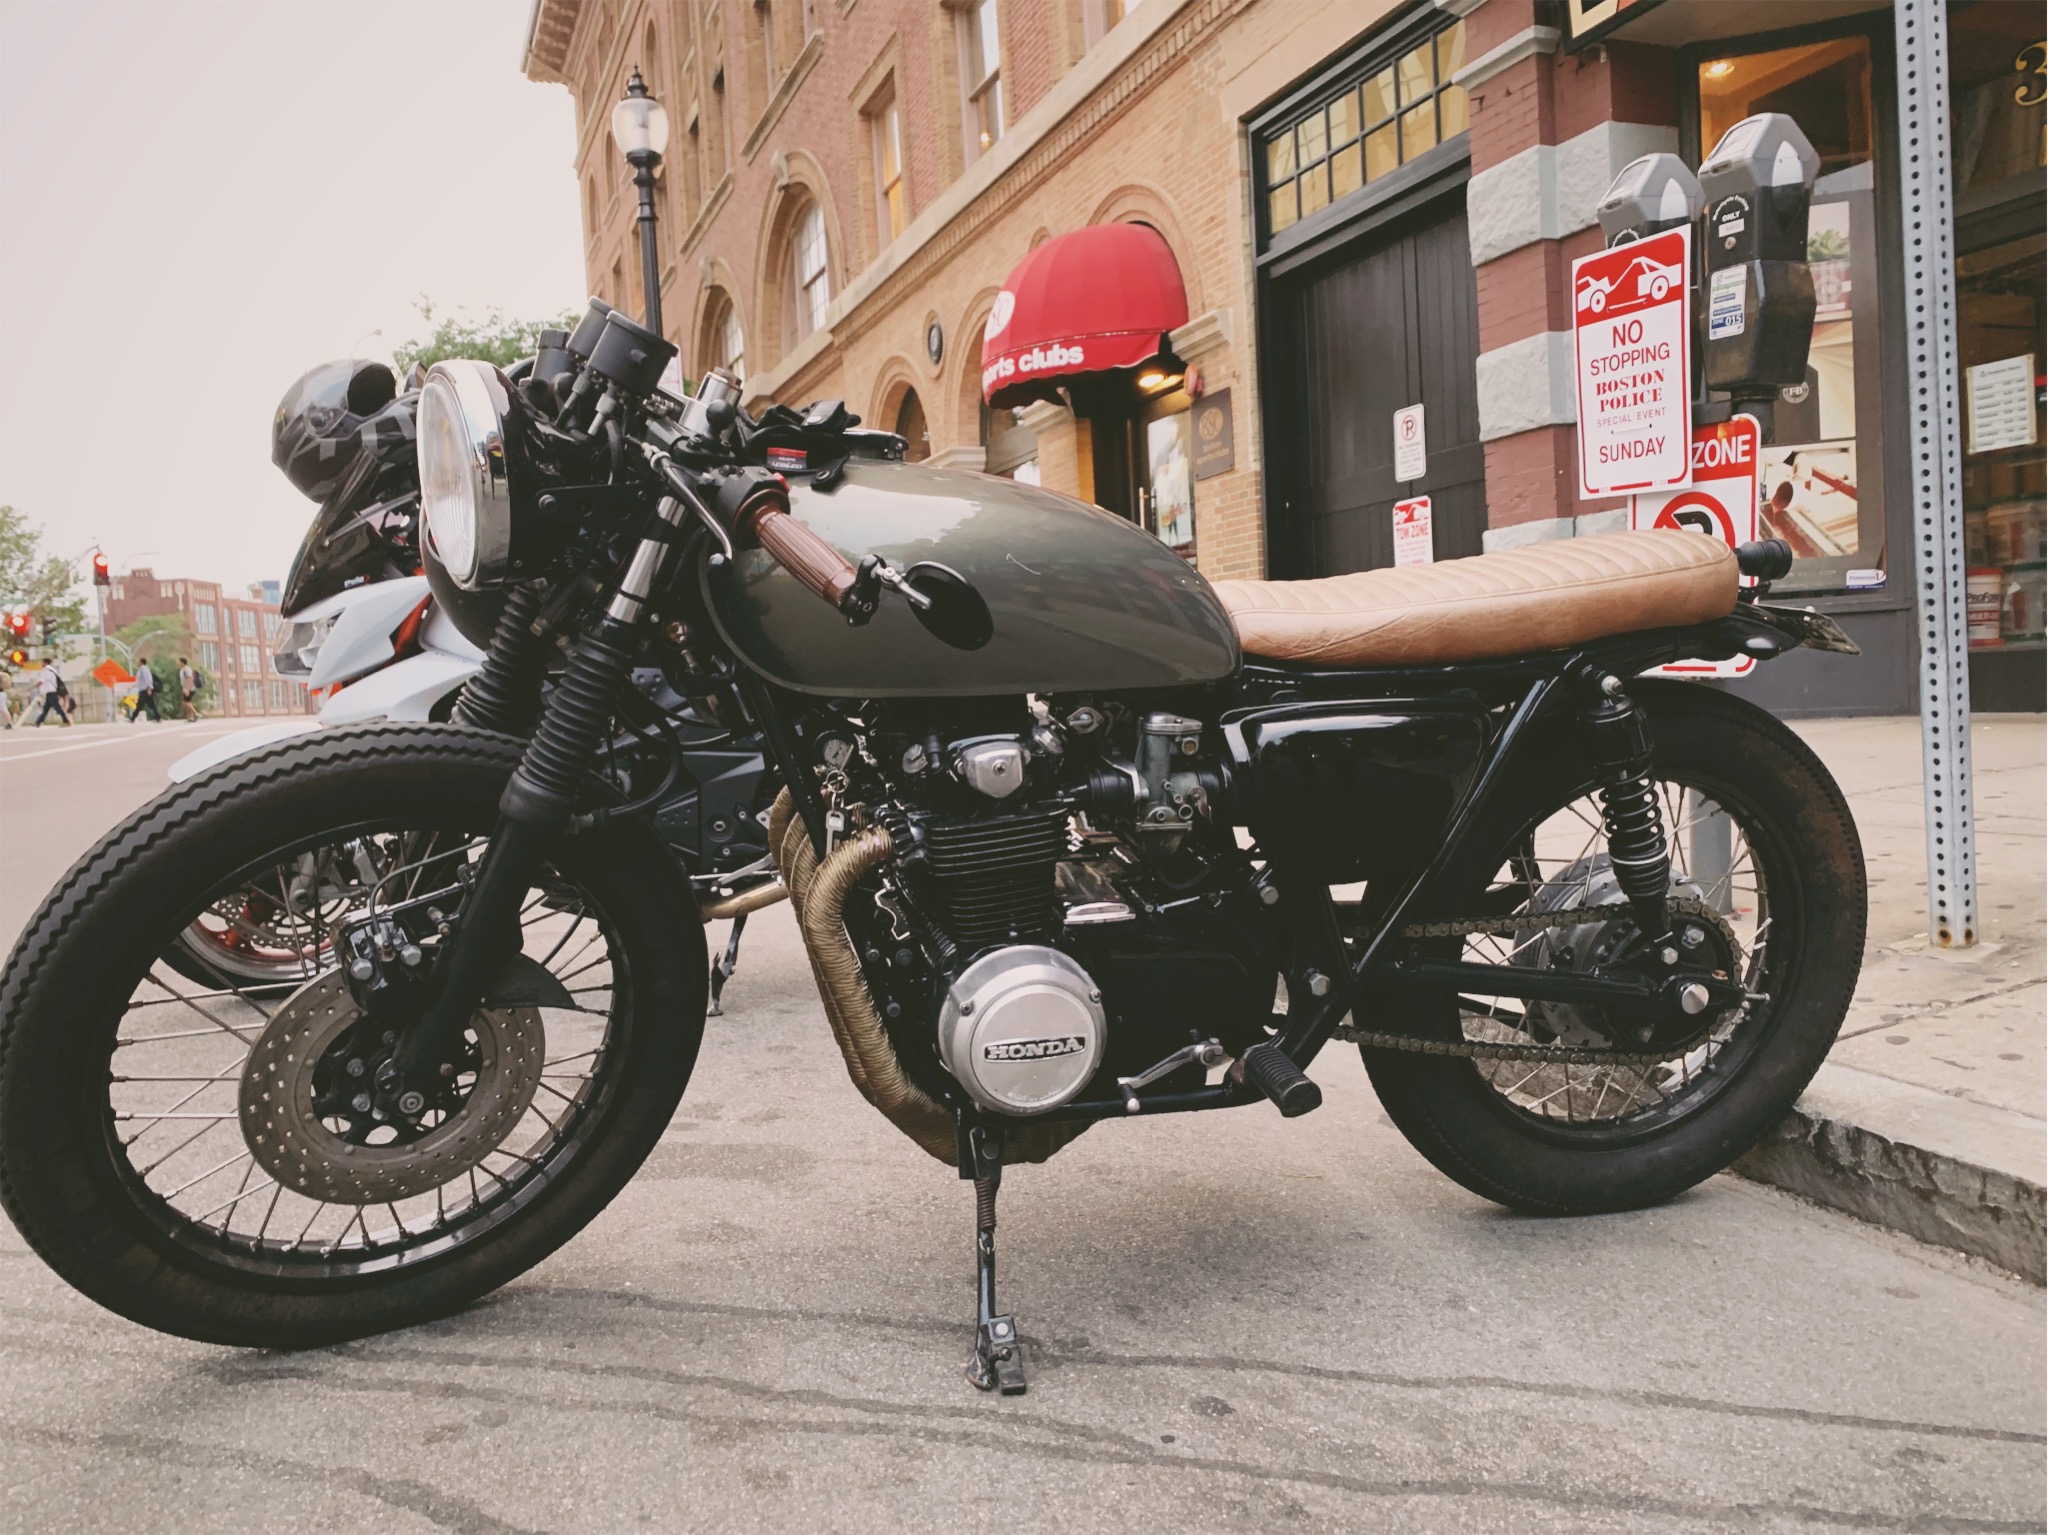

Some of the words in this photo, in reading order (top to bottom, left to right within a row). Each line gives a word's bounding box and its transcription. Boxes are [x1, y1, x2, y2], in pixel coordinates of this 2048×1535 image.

[1722, 210, 1741, 222] ONLY
[1725, 313, 1742, 327] 015
[1612, 319, 1643, 349] NO
[1018, 343, 1085, 372] clubs
[1590, 342, 1670, 376] STOPPING
[1596, 368, 1665, 396] BOSTON
[1600, 387, 1662, 413] POLICE
[1597, 414, 1632, 428] SPECIAL
[1637, 407, 1666, 420] EVENT
[1599, 436, 1666, 464] SUNDAY
[1692, 434, 1751, 469] ZONE
[1396, 527, 1409, 540] TOW
[1411, 522, 1429, 538] ZONE
[987, 1037, 1083, 1060] HONDA
